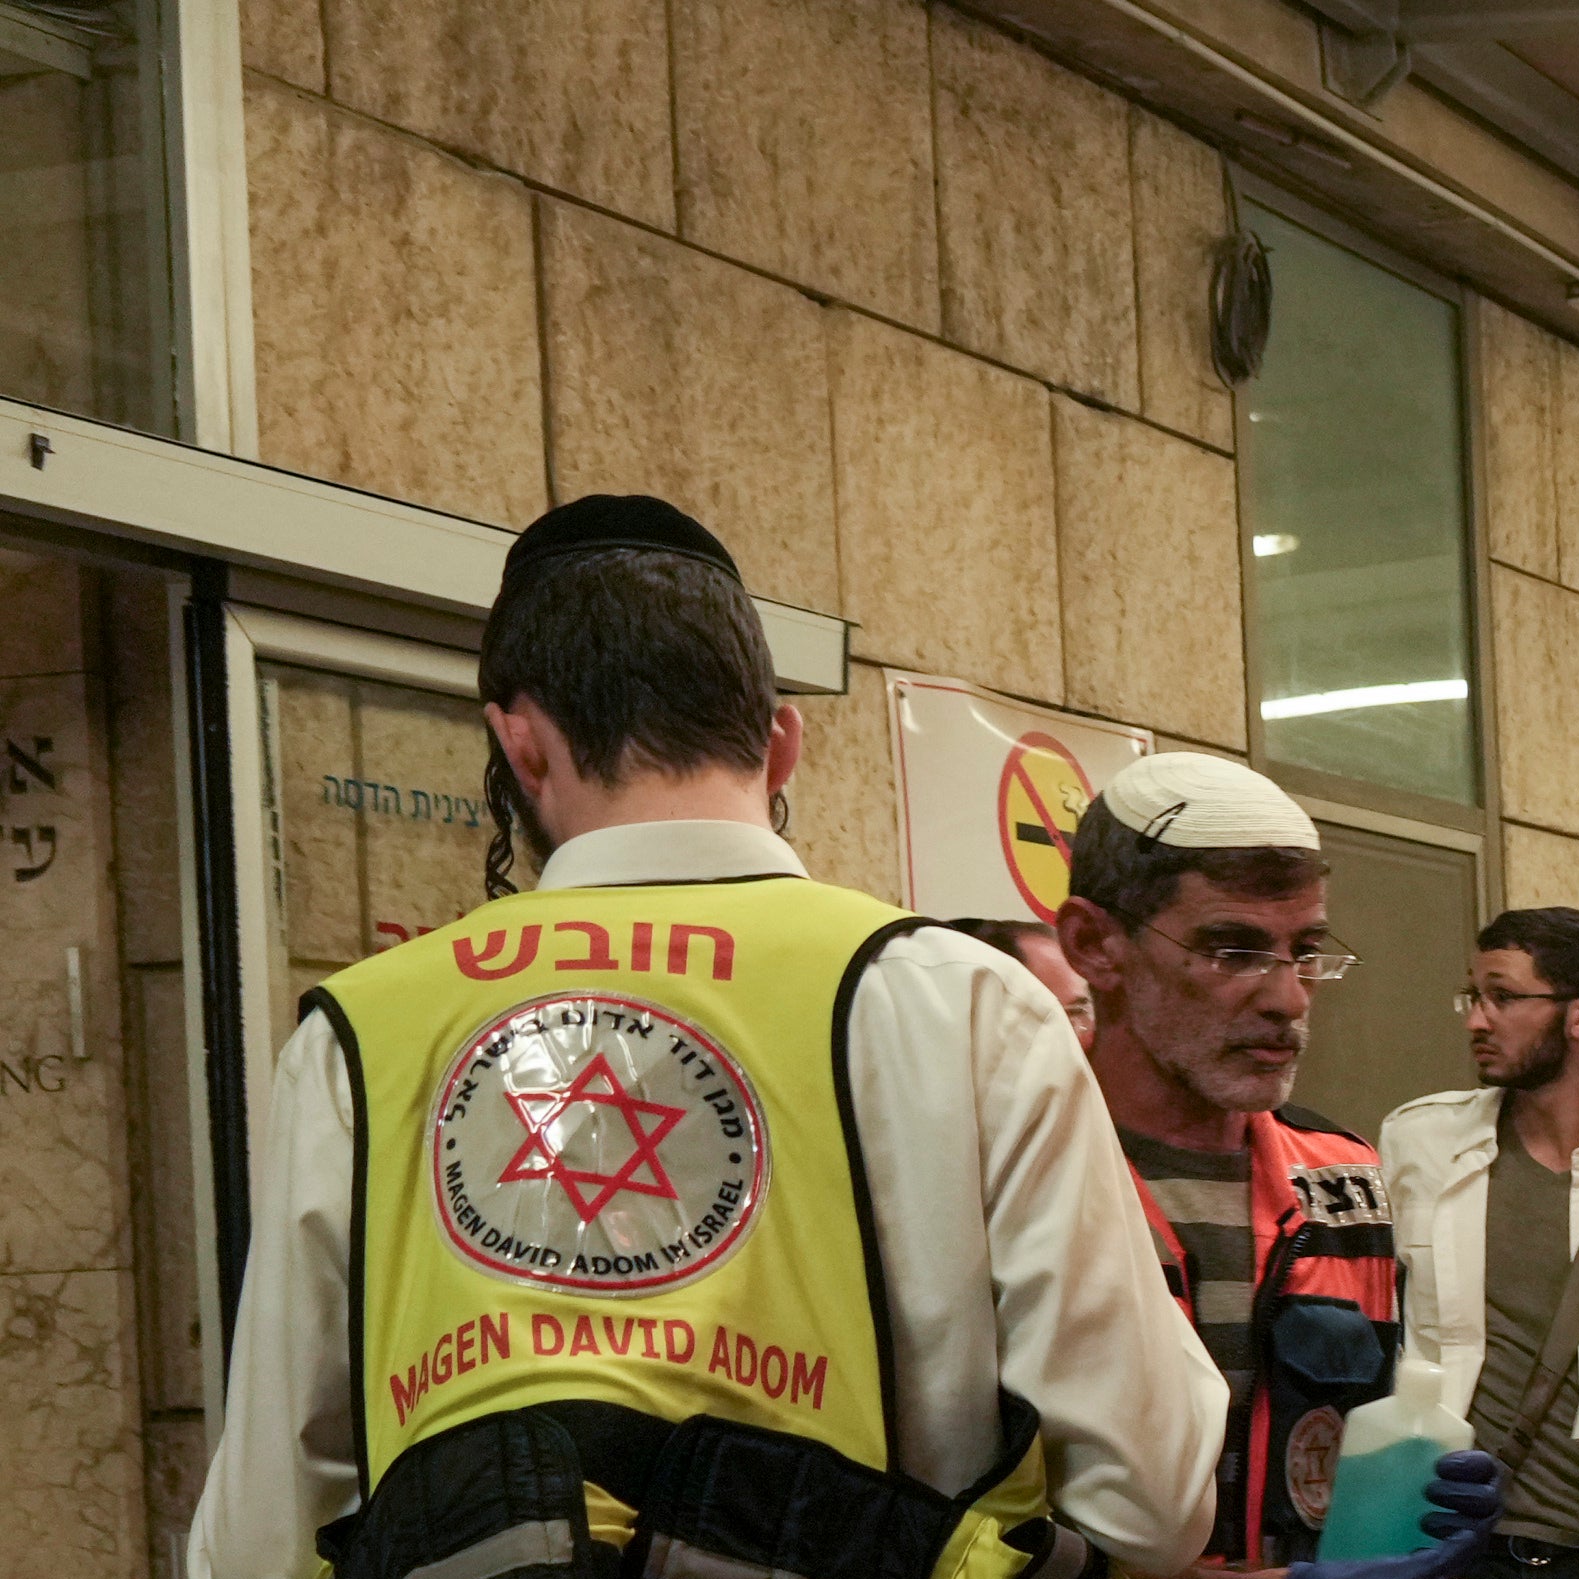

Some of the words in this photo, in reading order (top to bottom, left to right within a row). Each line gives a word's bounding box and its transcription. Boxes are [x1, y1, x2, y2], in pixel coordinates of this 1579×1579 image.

[452, 921, 735, 981] חובש
[561, 1010, 653, 1039] אדום
[669, 1034, 716, 1080] דוד
[703, 1088, 744, 1138] מגן
[446, 1160, 482, 1237] MAGEN
[480, 1227, 561, 1267] DAVID
[572, 1253, 659, 1275] ADOM
[660, 1239, 689, 1264] IN
[688, 1177, 743, 1248] ISRAEL
[389, 1312, 510, 1427] MAGEN
[531, 1313, 696, 1364] DAVID
[708, 1326, 828, 1410] ADOM
